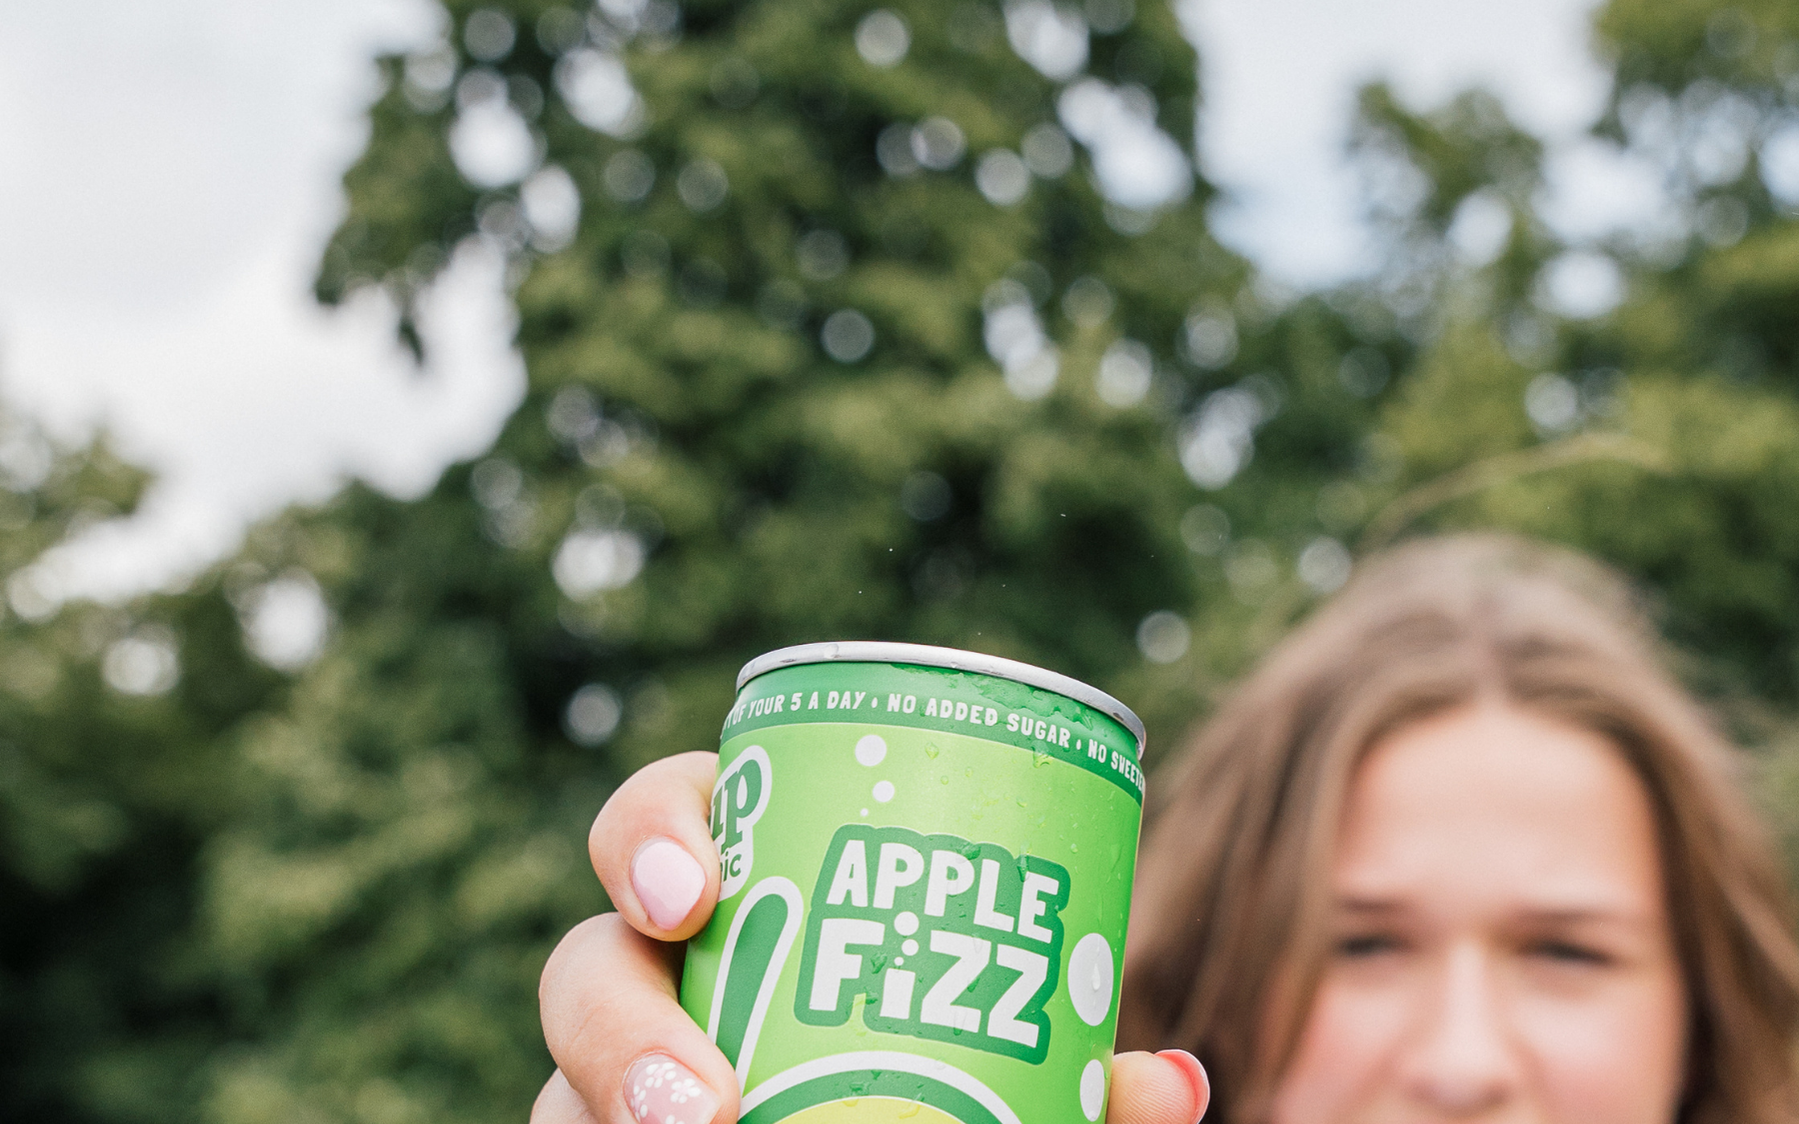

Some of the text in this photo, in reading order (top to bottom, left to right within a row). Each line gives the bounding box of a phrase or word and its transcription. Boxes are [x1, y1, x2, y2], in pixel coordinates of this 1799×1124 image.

[732, 703, 747, 726] OF
[747, 694, 785, 719] YOUR
[790, 692, 803, 711] 5
[807, 691, 819, 710] A
[827, 691, 866, 710] DAY
[887, 693, 917, 714] NO
[925, 698, 998, 727] ADDED
[1006, 713, 1071, 749] SUGAR
[1087, 739, 1107, 763] NO
[825, 839, 1060, 944] APPLE
